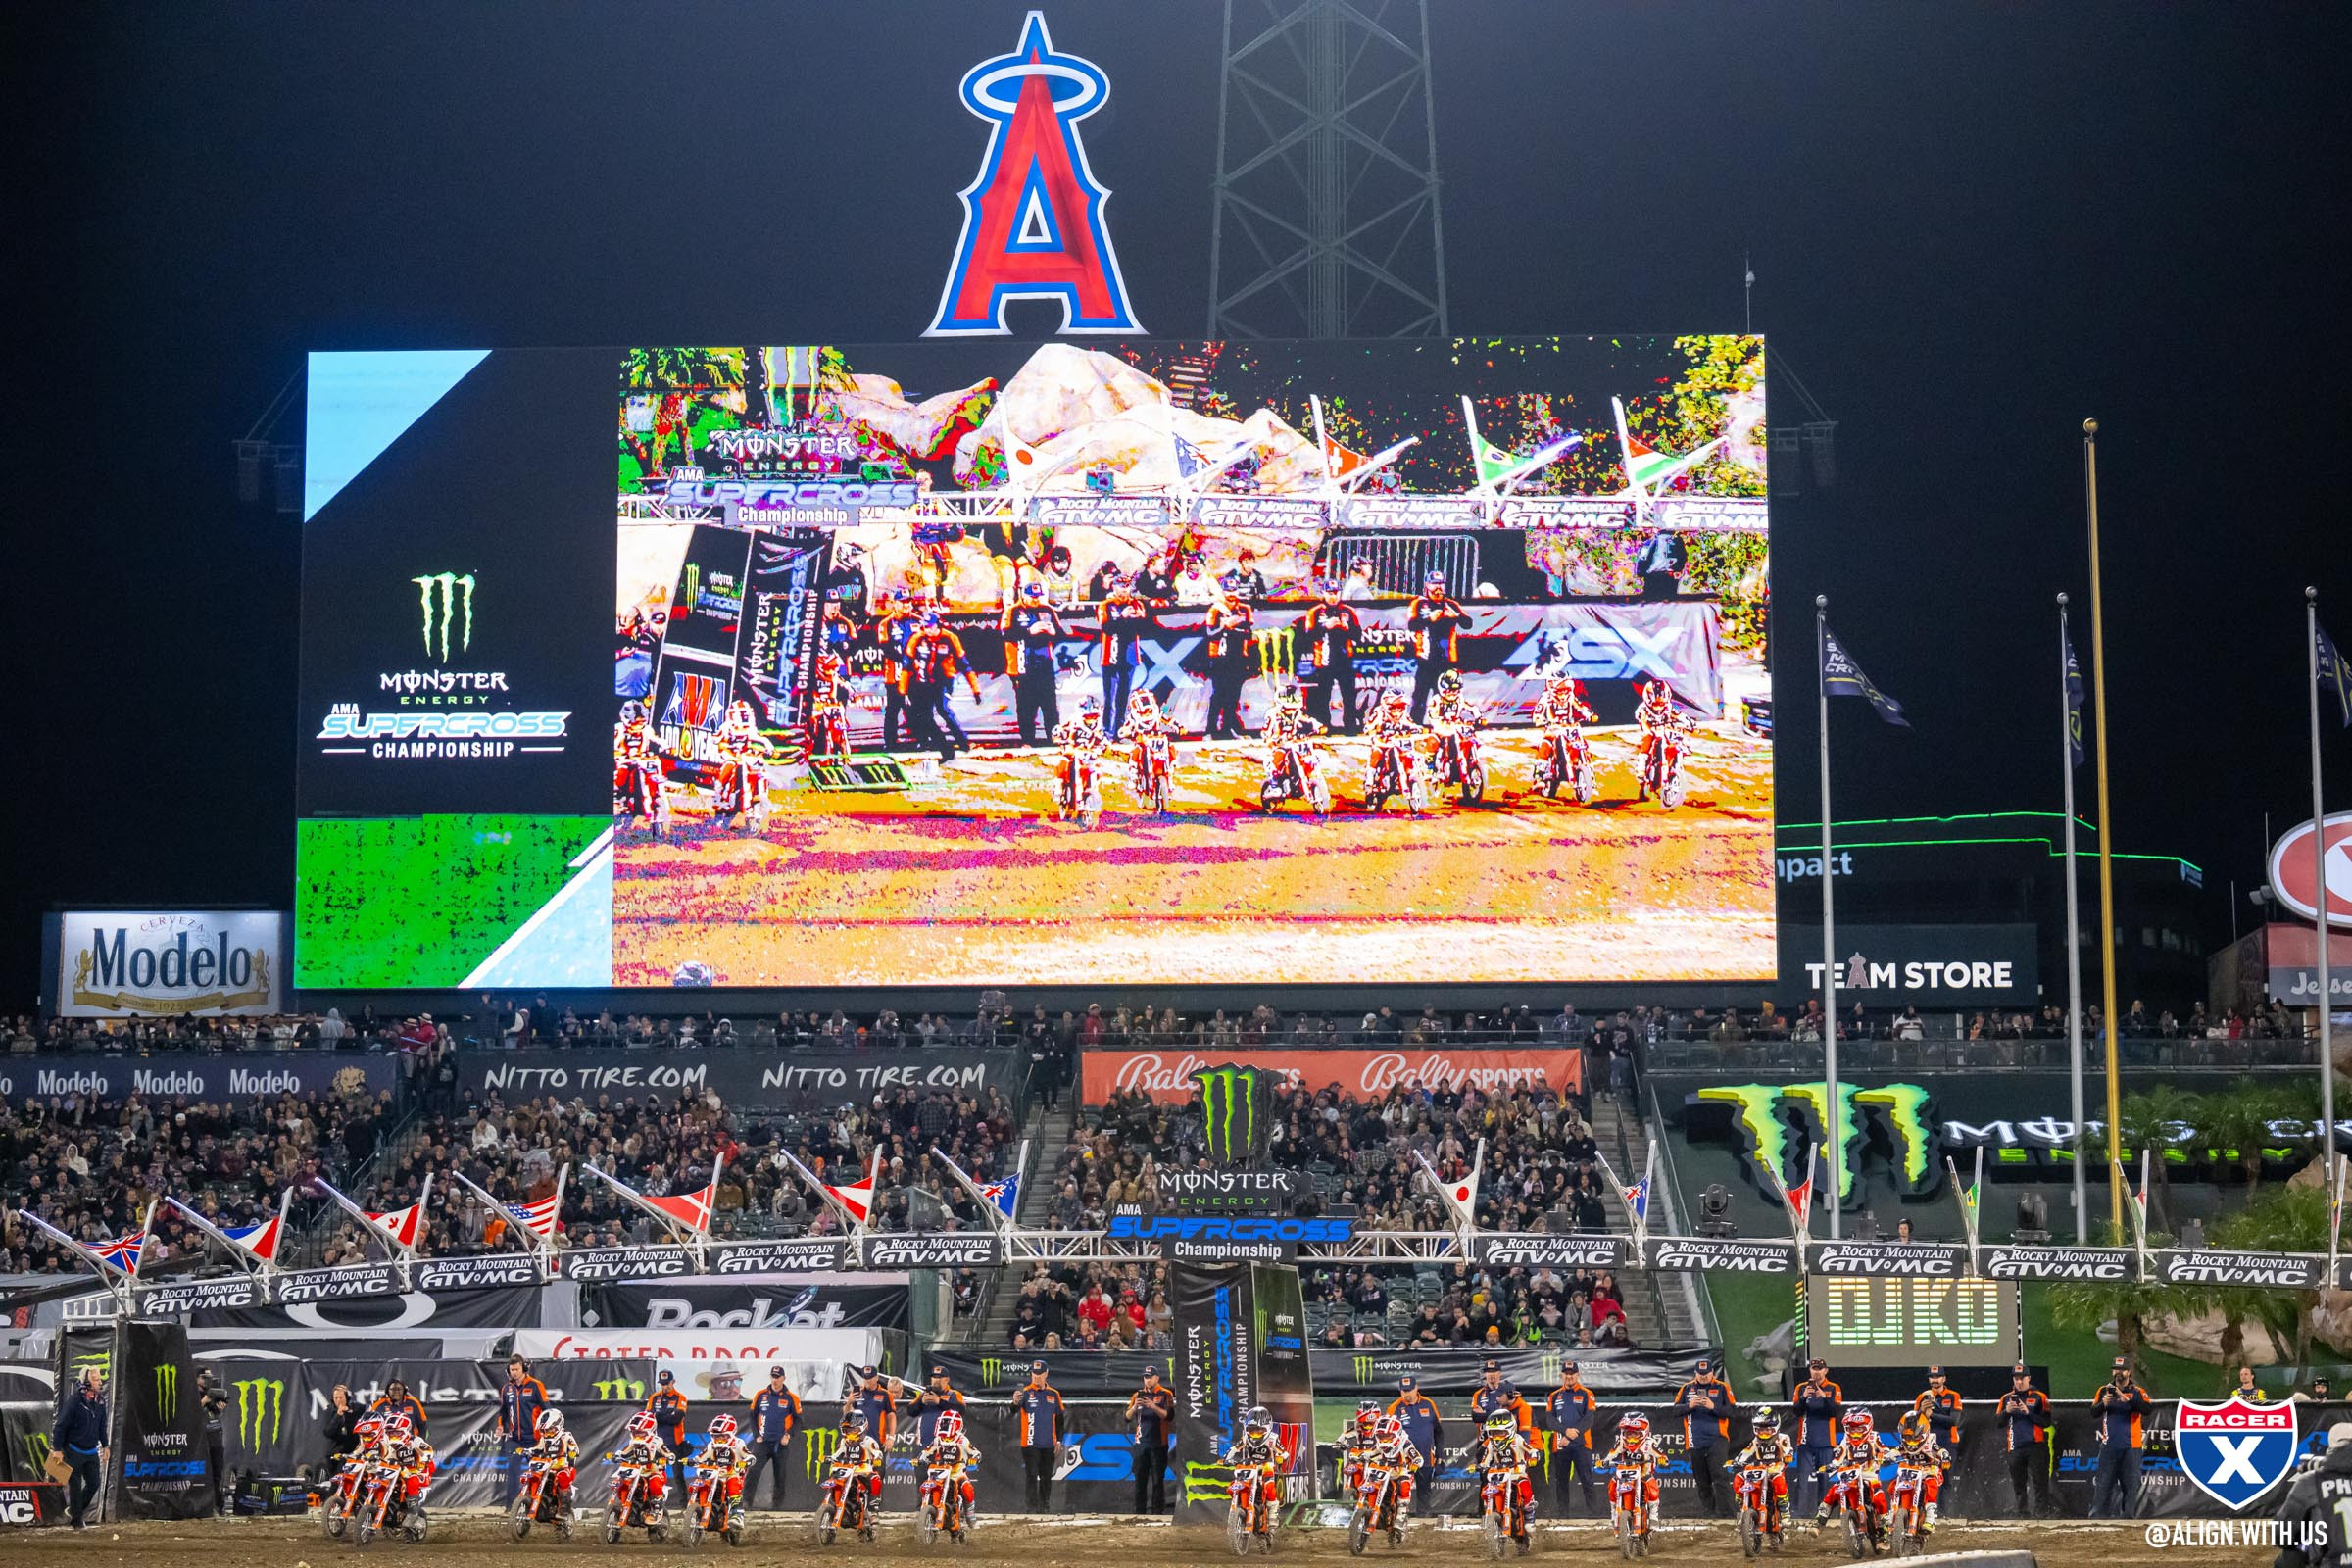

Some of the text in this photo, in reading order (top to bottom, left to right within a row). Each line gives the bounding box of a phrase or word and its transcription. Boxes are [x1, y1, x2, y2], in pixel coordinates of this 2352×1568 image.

[722, 428, 856, 461] MONSTER
[676, 468, 704, 483] AMA
[743, 461, 835, 471] ENERGY
[1056, 497, 1164, 510] ROCKY MOUNTAIN
[738, 505, 848, 526] Championship
[749, 592, 774, 686] MONSTER
[766, 606, 782, 672] ENERGY
[796, 589, 819, 690] CHAMPIONSHIP
[380, 669, 509, 694] MONSTER
[331, 703, 360, 715] AMA
[401, 695, 490, 705] ENERGY
[316, 711, 572, 739] SUPERCROSS
[372, 742, 514, 759] CHAMPIONSHIP
[140, 915, 205, 932] CERVEZA
[92, 928, 251, 988] Modelo
[1805, 952, 2014, 990] TEAM STORE
[37, 1069, 108, 1095] Modelo
[133, 1069, 204, 1095] Modelo
[229, 1068, 300, 1094] Modelo
[485, 1062, 708, 1090] NITTO TIRE.COM
[761, 1061, 986, 1090] NITTO TIRE.COM
[1360, 1054, 1546, 1093] Bally SPORTS
[1159, 1167, 1293, 1193] MONSTER
[1116, 1204, 1143, 1216] AMA
[1181, 1197, 1270, 1206] ENERGY
[1106, 1216, 1355, 1242] SUPERCROSS
[736, 1244, 835, 1257] ROCKY MOUNTAIN
[890, 1238, 992, 1250] ROCKY MOUNTAIN
[1174, 1240, 1283, 1261] Championship
[1506, 1238, 1615, 1250] ROCKY MOUNTAIN
[1677, 1241, 1788, 1258] ROCKY MOUNTAIN
[1839, 1245, 1954, 1259] ROCKY MOUNTAIN
[437, 1258, 532, 1272] ROCKY MOUNTAIN
[588, 1250, 684, 1263] ROCKY MOUNTAIN
[2011, 1249, 2127, 1263] ROCKY MOUNTAIN
[2189, 1253, 2309, 1269] ROCKY MOUNTAIN
[295, 1268, 389, 1286] ROCKY MOUNTAIN
[161, 1282, 252, 1299] ROCKY MOUNTAIN
[1828, 1276, 1904, 1345] DJ
[1186, 1325, 1202, 1419] MONSTER
[1214, 1285, 1233, 1459] SUPERCROSS
[1374, 1359, 1423, 1371] MONSTER
[143, 1432, 188, 1447] MONSTER
[1209, 1434, 1219, 1456] AMA
[140, 1480, 192, 1493] CHAMPIONSHIP
[1286, 1475, 1309, 1503] YEARS
